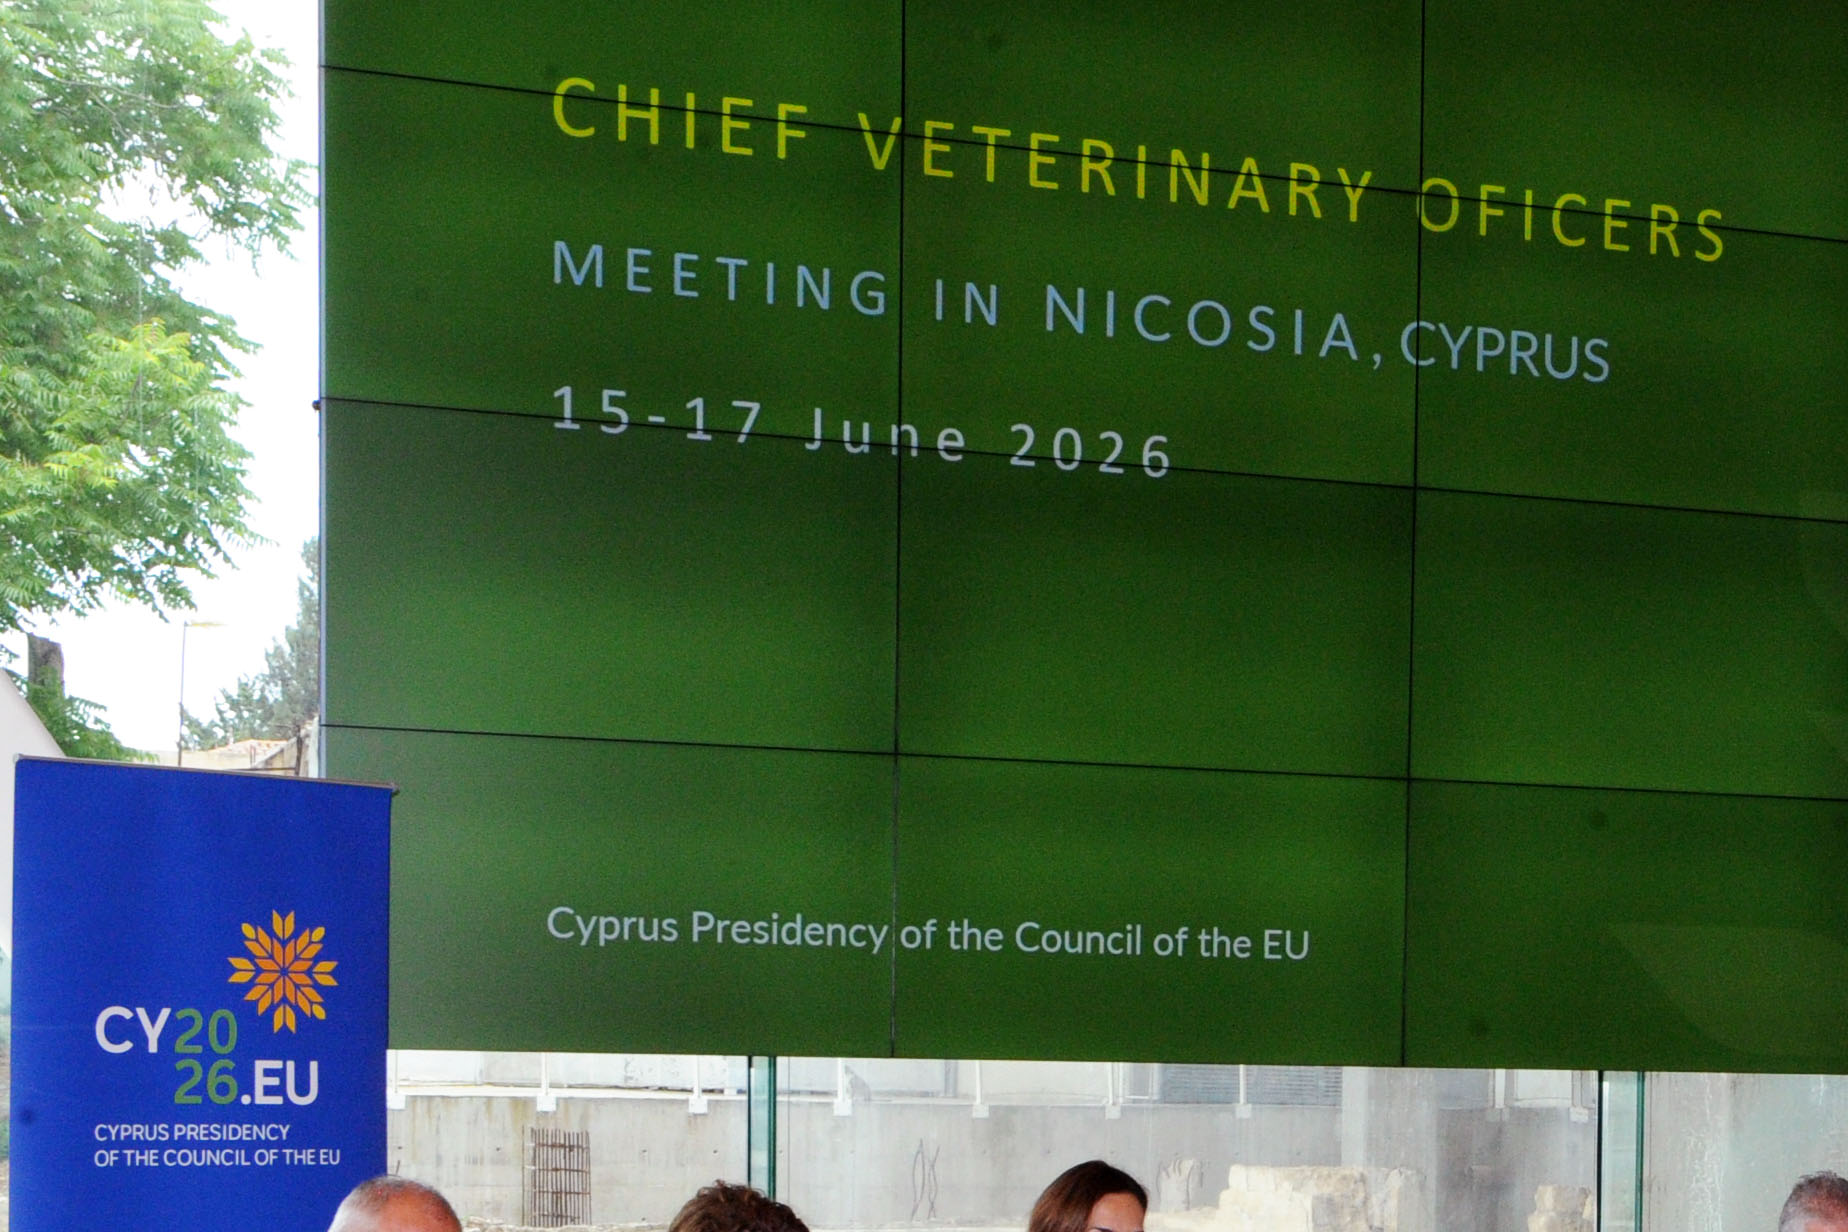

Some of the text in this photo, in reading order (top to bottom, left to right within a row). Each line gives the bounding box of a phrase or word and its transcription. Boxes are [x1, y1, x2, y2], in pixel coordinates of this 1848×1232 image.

[552, 77, 1724, 262] CHIEF VETERINARY OFICERS
[552, 240, 1610, 383] MEETING IN NICOSIA, CYPRUS
[552, 385, 1170, 478] 15-17 June 2026
[546, 906, 1310, 960] Cyprus Presidency of the Council of the EU
[94, 1005, 238, 1055] CY20
[174, 1058, 319, 1107] 26.EU
[94, 1123, 290, 1142] CYPRUS PRESIDENCY
[94, 1149, 341, 1167] OF THE COUNCIL OF THE EU
